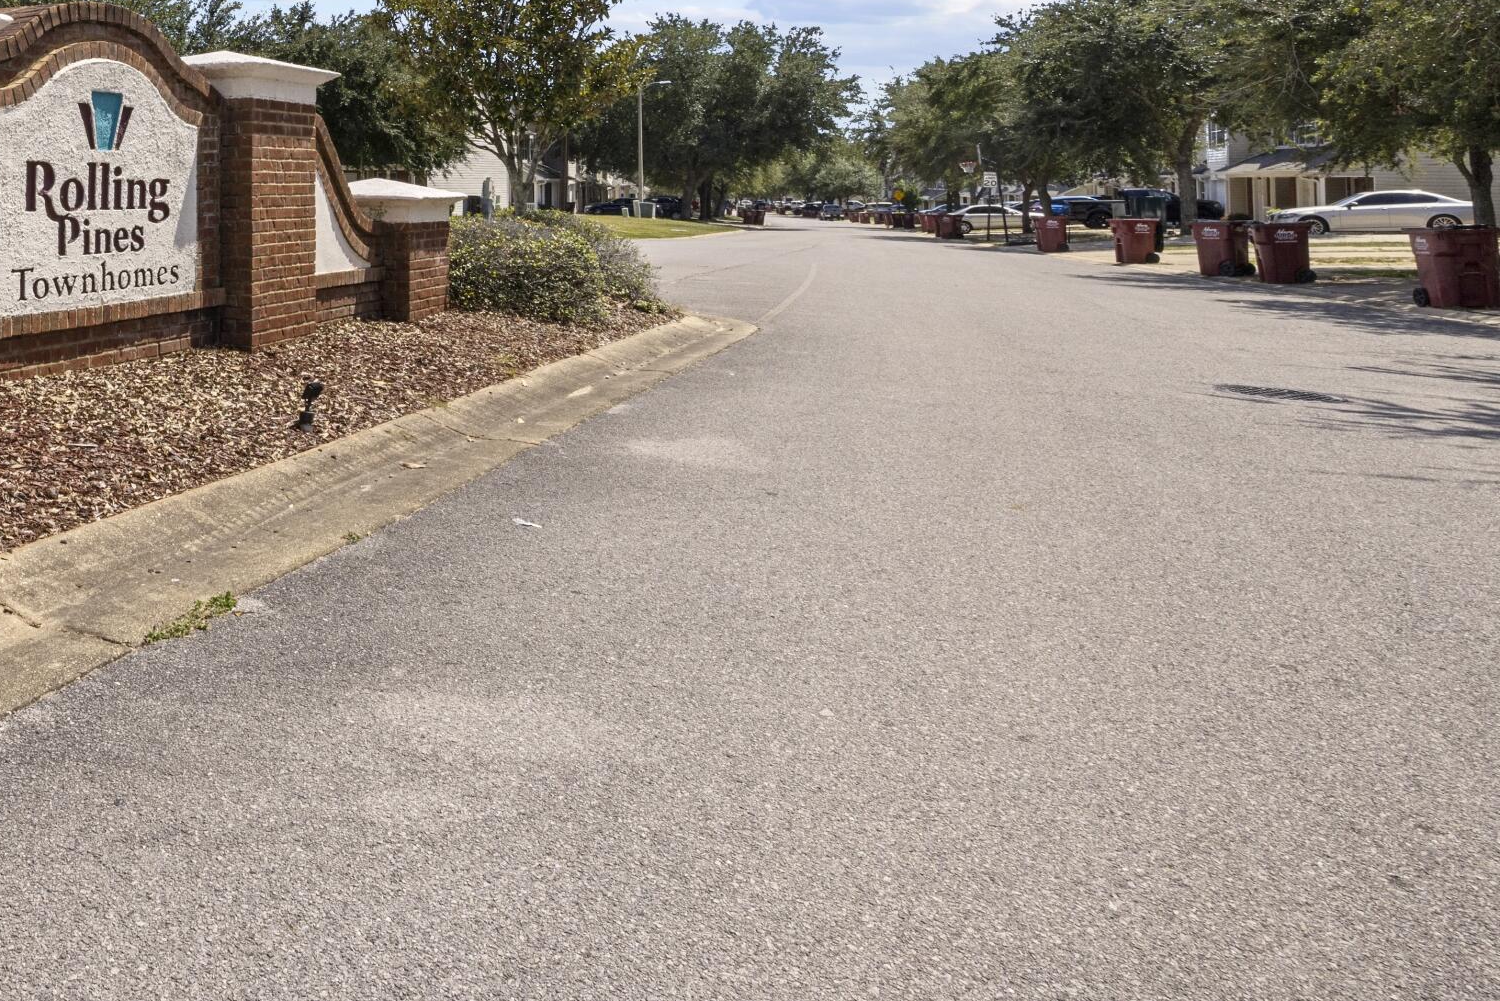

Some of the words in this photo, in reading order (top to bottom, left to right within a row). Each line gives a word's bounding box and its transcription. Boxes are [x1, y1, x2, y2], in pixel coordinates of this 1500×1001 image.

[25, 160, 170, 223] Rolling
[57, 213, 145, 256] Pines
[11, 261, 179, 301] Townhomes
